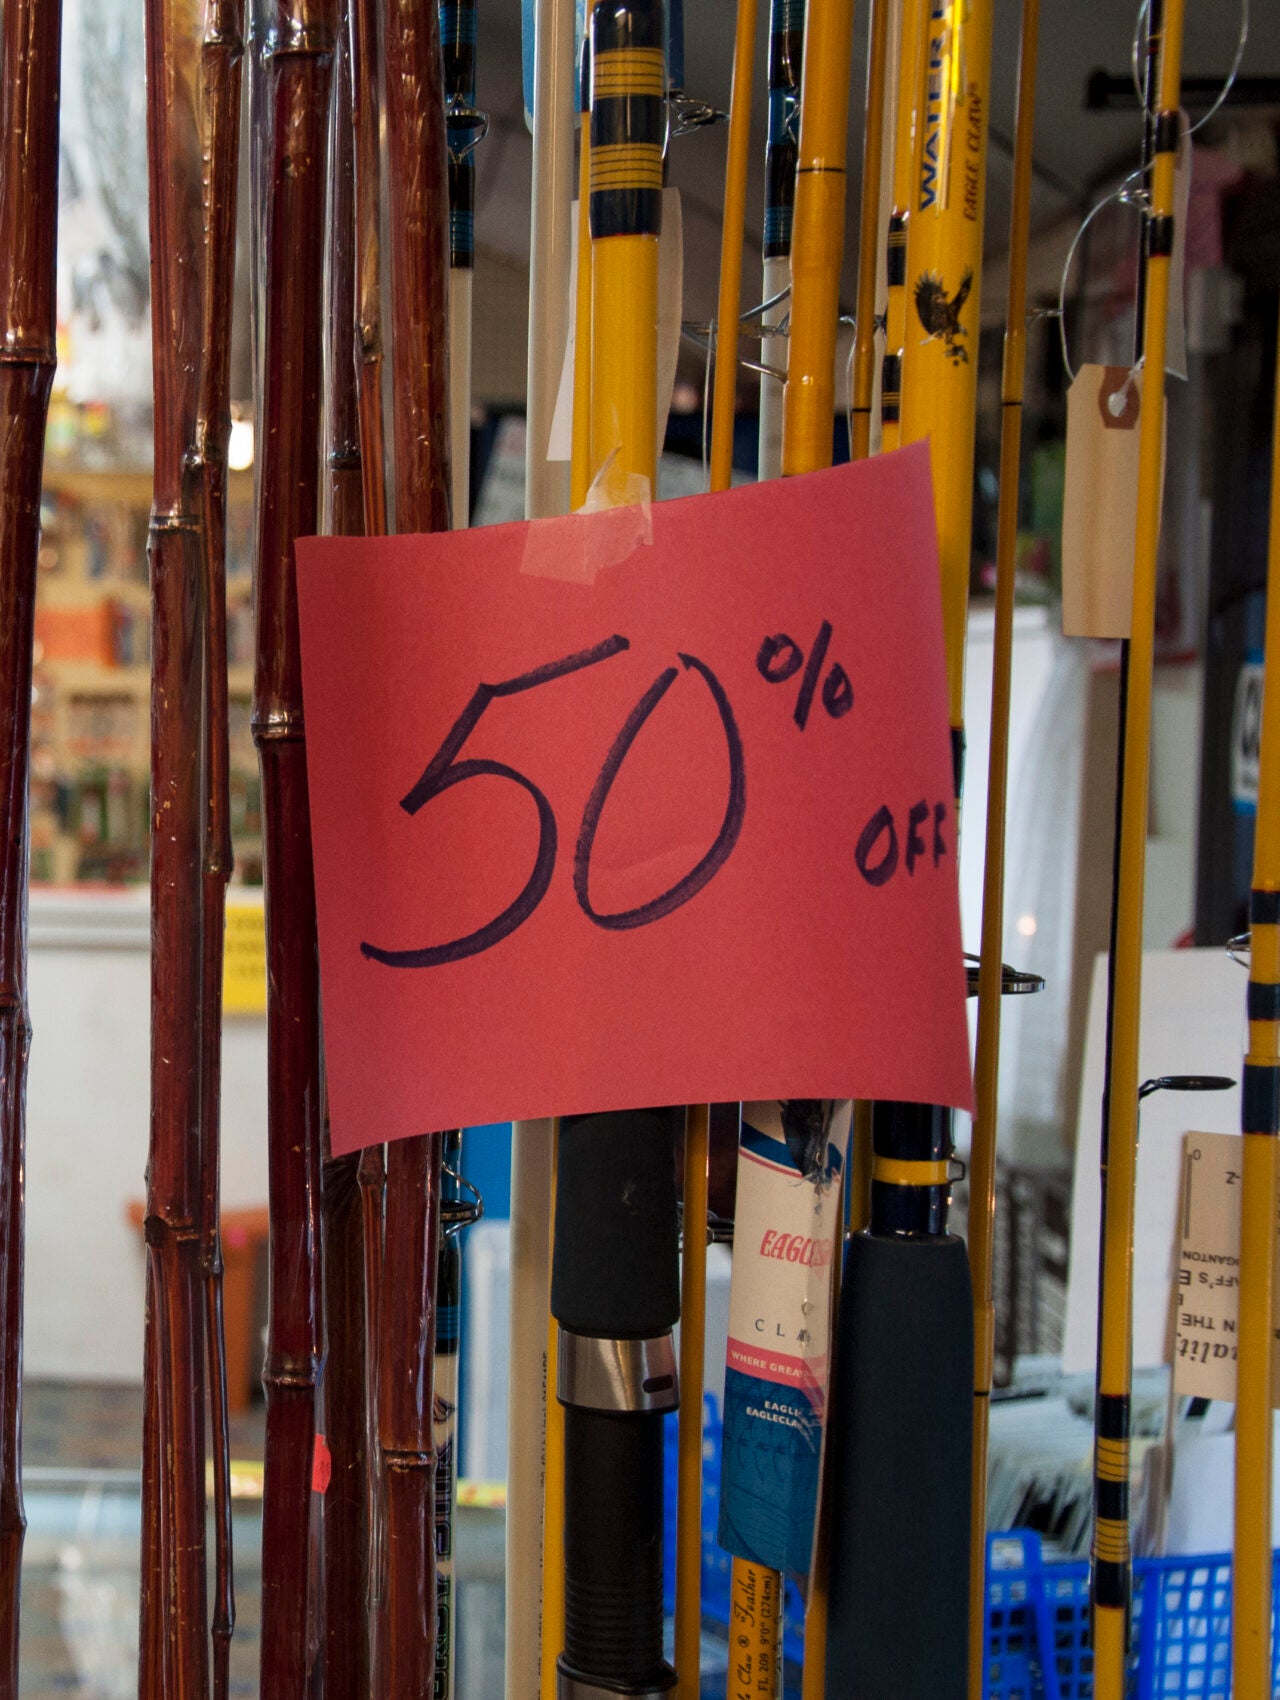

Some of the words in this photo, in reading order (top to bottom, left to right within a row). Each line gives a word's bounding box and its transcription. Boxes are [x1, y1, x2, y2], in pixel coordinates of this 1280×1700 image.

[854, 798, 948, 888] OFF
[1181, 1313, 1215, 1330] THE
[731, 1350, 767, 1369] WHERE
[737, 1654, 752, 1685] Claw
[759, 1653, 769, 1672] 209
[758, 1679, 769, 1691] FL
